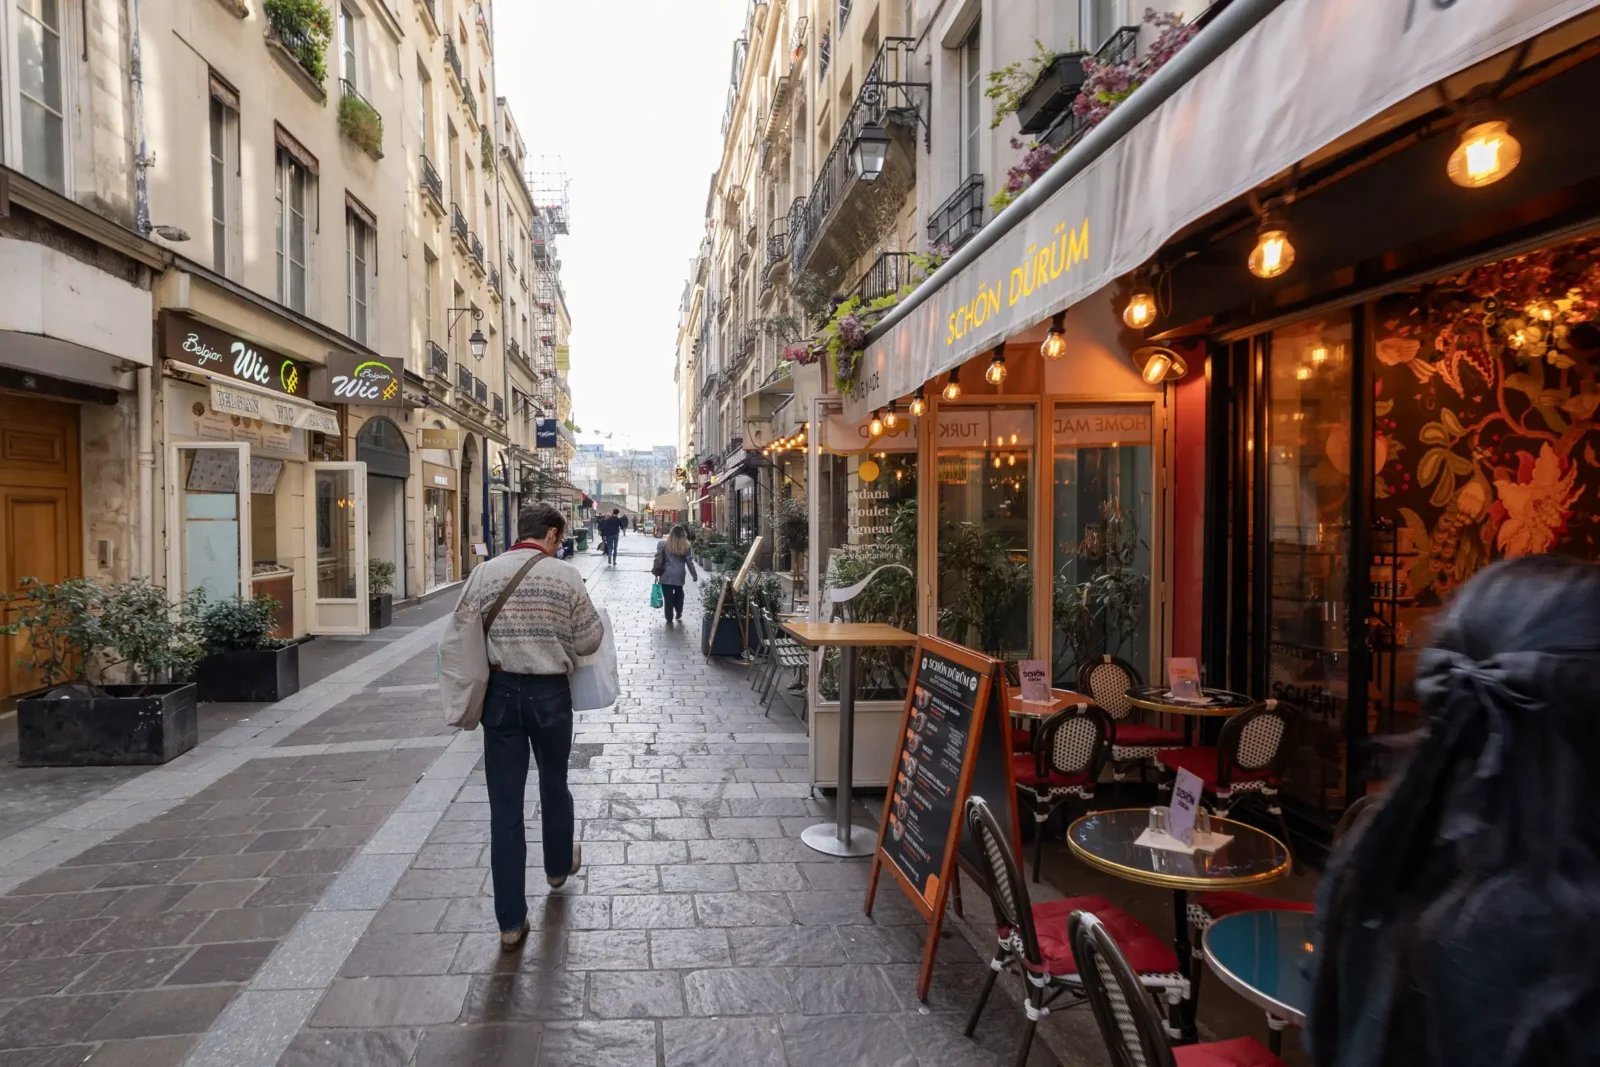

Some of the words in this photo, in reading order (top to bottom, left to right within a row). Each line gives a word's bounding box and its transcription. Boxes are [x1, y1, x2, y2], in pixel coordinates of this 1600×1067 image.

[947, 280, 1001, 345] SCHÖN
[1008, 218, 1090, 306] DÜRÜM
[182, 333, 223, 365] Belgian
[231, 342, 270, 384] Wic
[359, 368, 391, 381] Belgian
[332, 375, 379, 399] Wic
[216, 390, 259, 413] BELGIAN
[275, 404, 294, 421] WIC
[850, 488, 890, 500] Adana
[850, 505, 891, 517] Poulet
[847, 524, 894, 537] Agneau
[842, 543, 873, 551] Recette
[928, 658, 947, 677] SCHÖN
[947, 667, 970, 687] DÜRÜM
[1022, 669, 1045, 678] SCHÖN
[1175, 786, 1196, 806] SCHÖN
